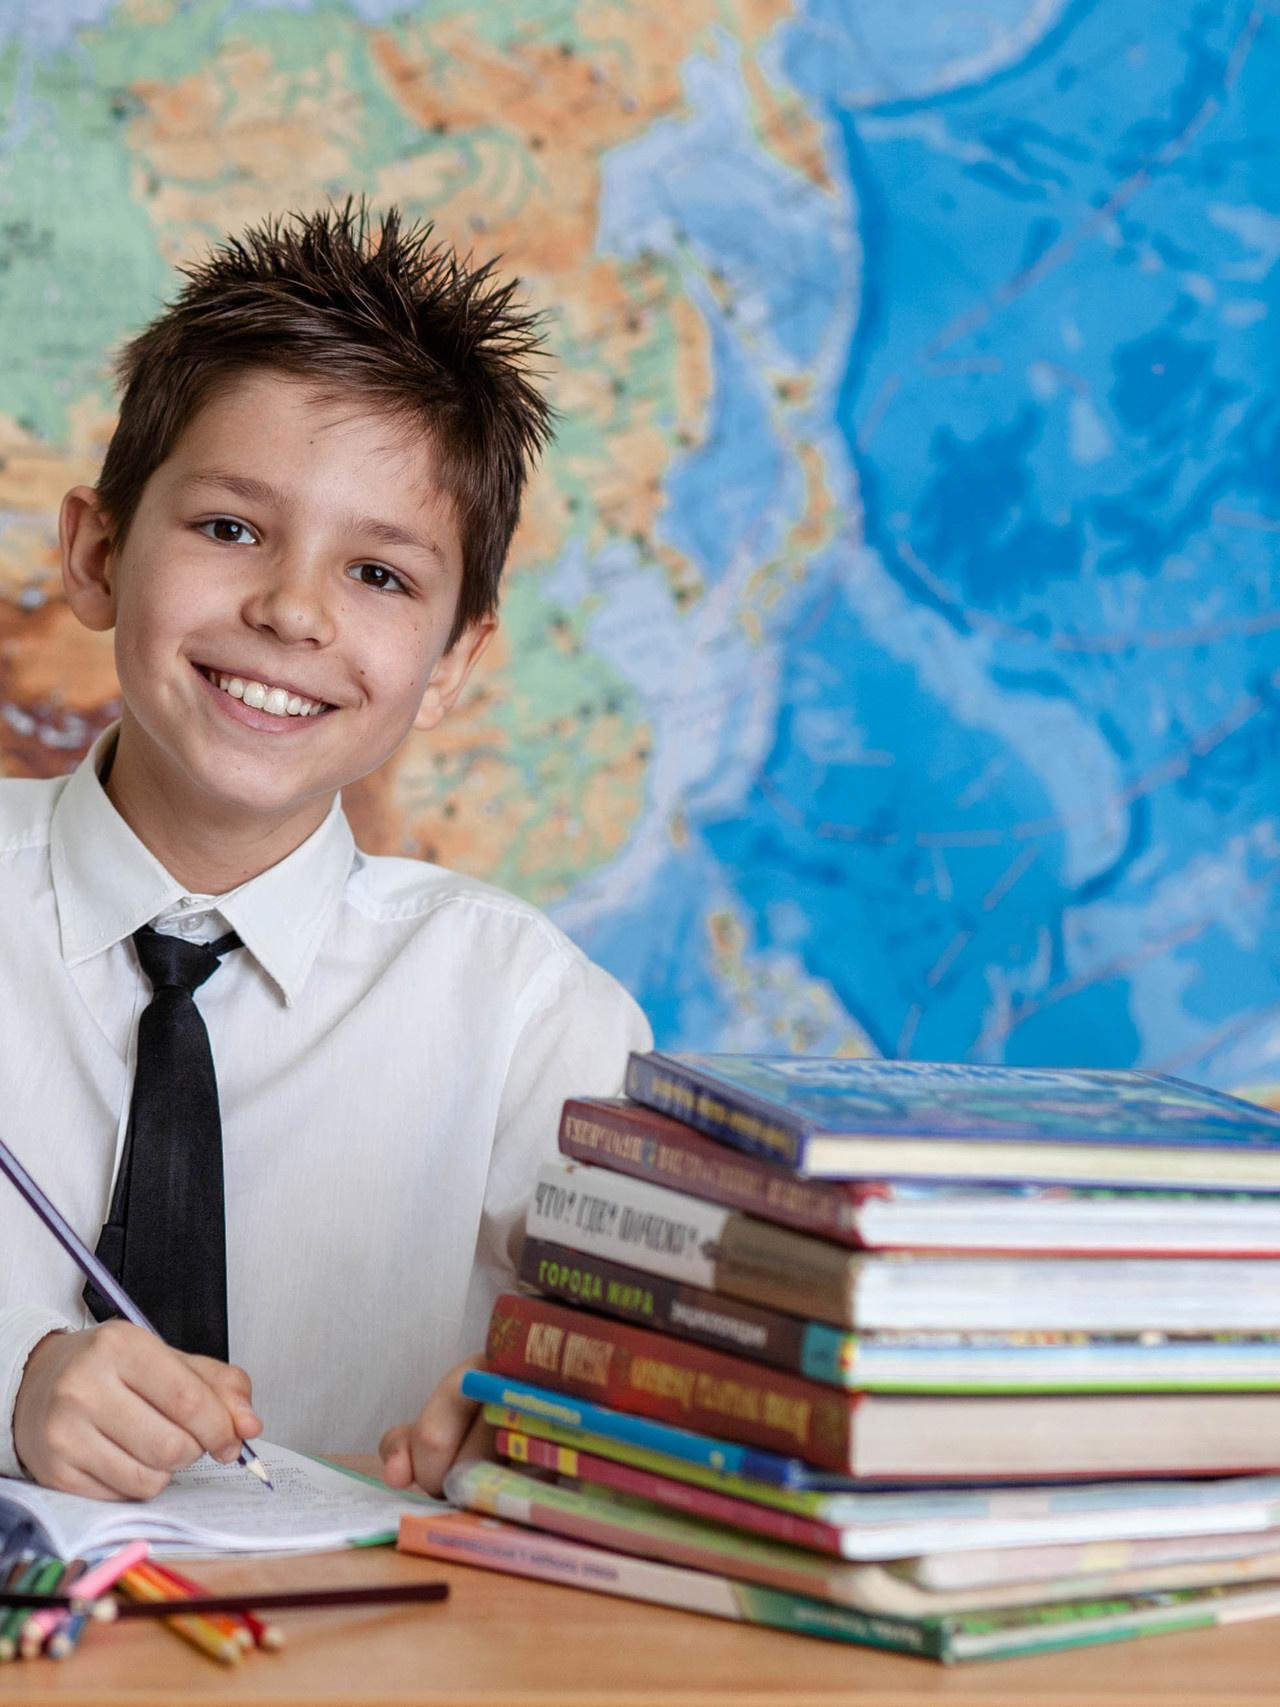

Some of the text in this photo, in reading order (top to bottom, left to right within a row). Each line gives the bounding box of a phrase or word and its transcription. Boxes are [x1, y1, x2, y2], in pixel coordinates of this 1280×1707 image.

[535, 1181, 577, 1224] ЧТО?
[576, 1194, 618, 1236] ГДЕ?
[538, 1260, 653, 1316] ГОРОДА МИРА
